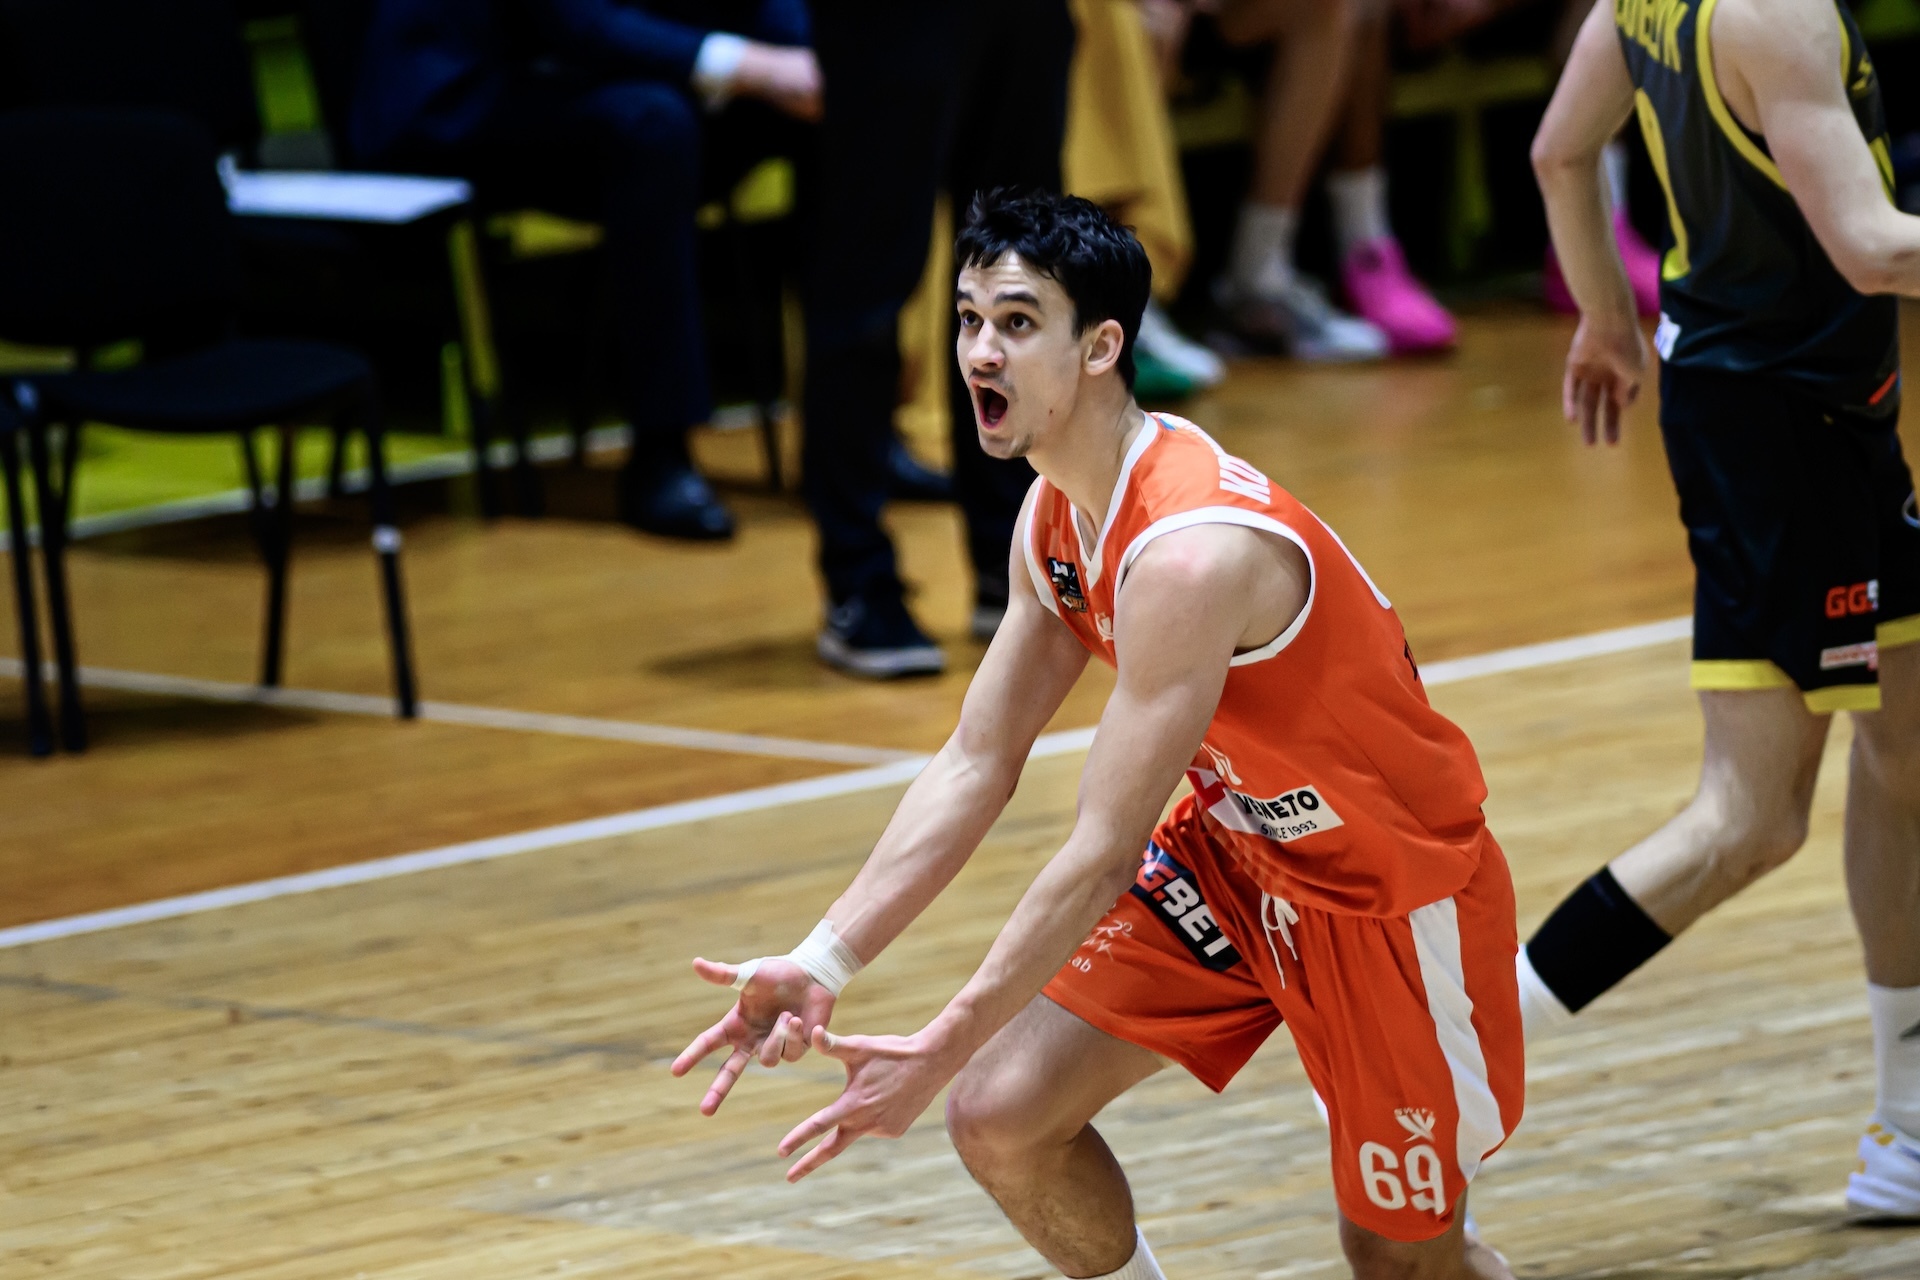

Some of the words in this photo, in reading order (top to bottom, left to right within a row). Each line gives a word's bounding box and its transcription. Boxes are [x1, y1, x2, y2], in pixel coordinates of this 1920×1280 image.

[1235, 790, 1319, 820] VENETO
[1260, 823, 1288, 839] SINCE
[1288, 820, 1317, 836] 1993
[1358, 1141, 1447, 1216] 69
